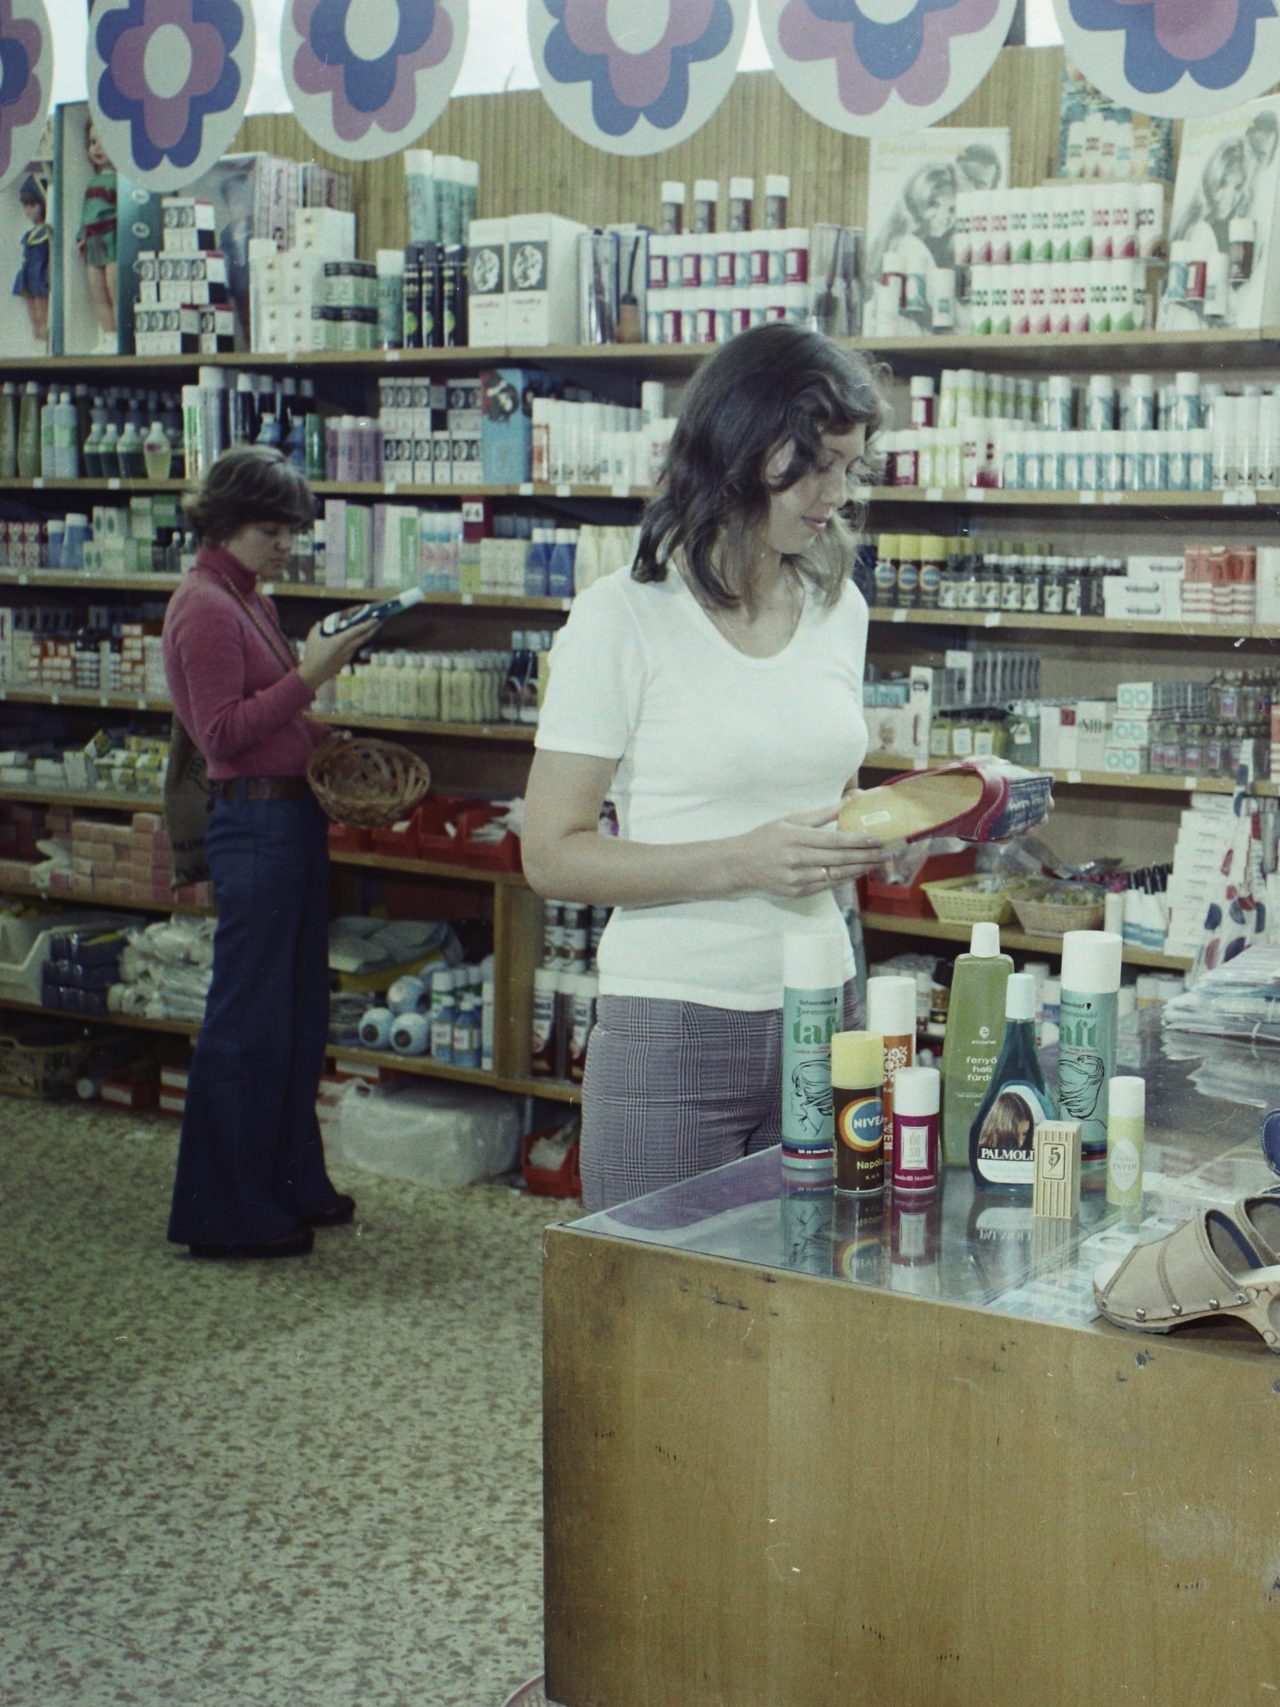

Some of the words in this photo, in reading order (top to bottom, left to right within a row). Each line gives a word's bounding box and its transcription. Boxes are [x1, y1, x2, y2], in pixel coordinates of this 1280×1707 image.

[792, 1016, 841, 1045] taf
[1059, 1019, 1097, 1048] aft
[967, 1073, 993, 1081] fürd
[981, 1147, 1035, 1160] PALMOLI
